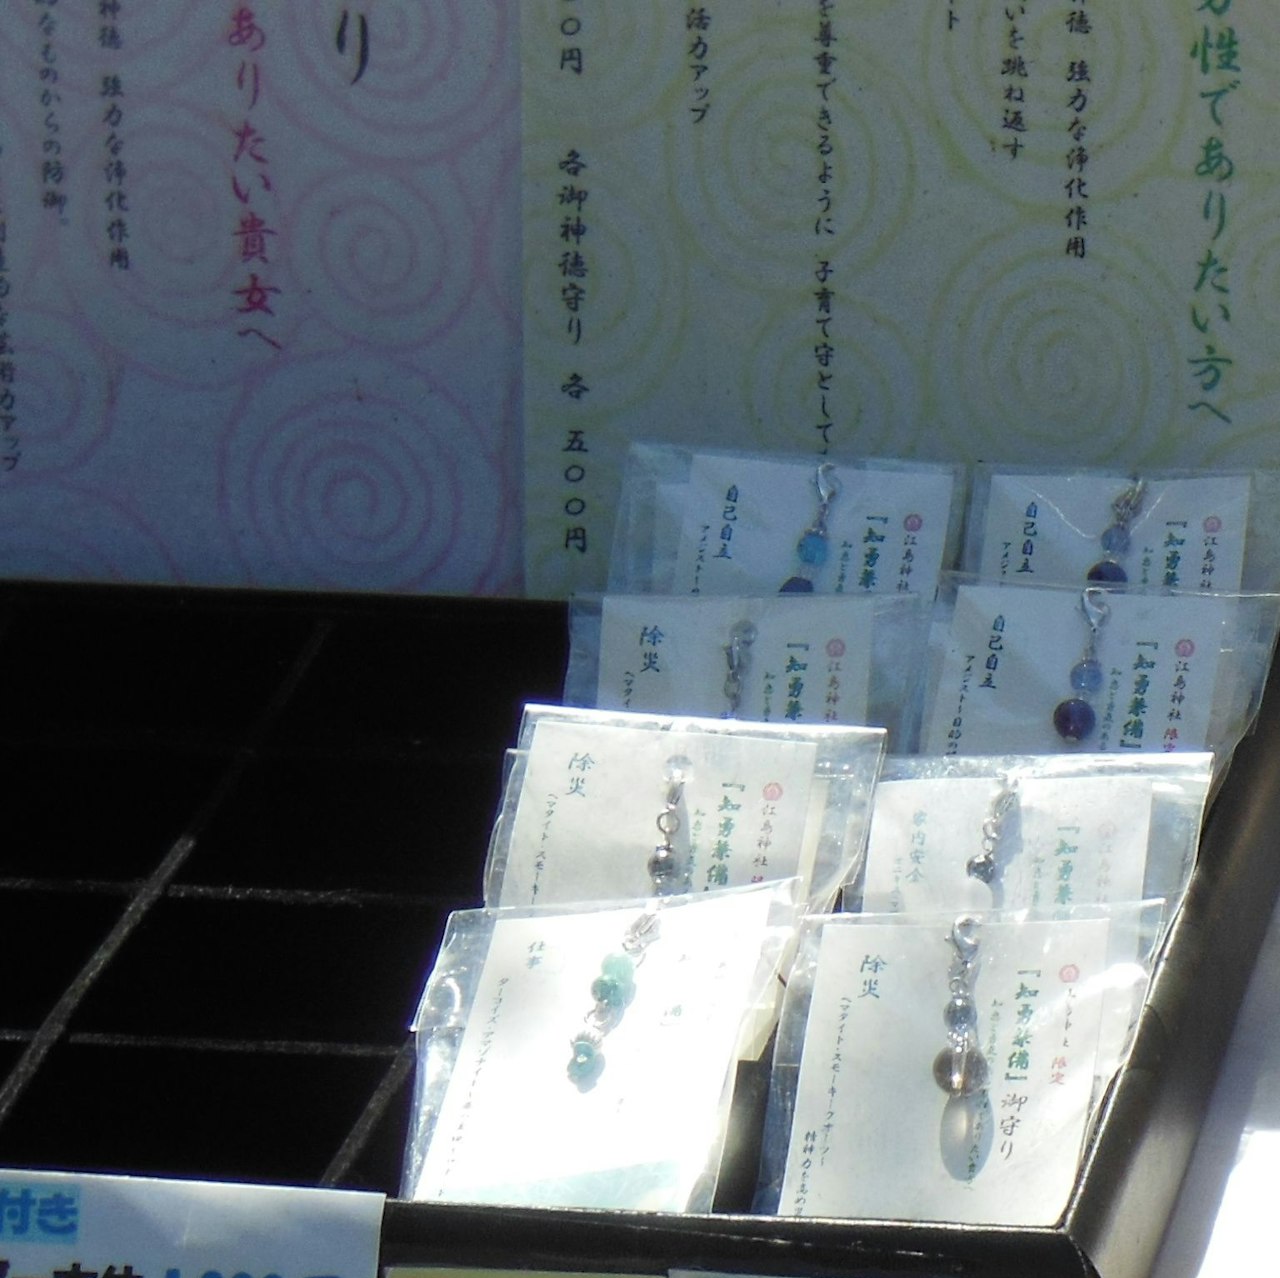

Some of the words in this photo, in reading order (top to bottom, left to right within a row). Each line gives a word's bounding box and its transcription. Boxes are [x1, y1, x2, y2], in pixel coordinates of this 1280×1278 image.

[336, 10, 370, 86] り
[560, 0, 583, 75] 〇円
[943, 0, 960, 31] ト
[1065, 0, 1093, 35] 徳
[685, 8, 712, 125] 活力アップ
[1000, 0, 1029, 160] いを跳ね返す
[38, 0, 69, 226] なものからの防御。
[228, 7, 283, 350] ありたい貴女へ
[1063, 60, 1092, 258] 強力な浄化作用
[560, 372, 590, 399] 各
[813, 260, 836, 456] 子育て守として
[712, 484, 740, 560] 自己自立
[1015, 502, 1038, 574] 自己自立
[639, 624, 665, 674] 除災
[979, 614, 1007, 690] 自己自立
[565, 752, 598, 798] 除災
[857, 954, 888, 1000] 除災
[0, 1188, 79, 1236] 付き
